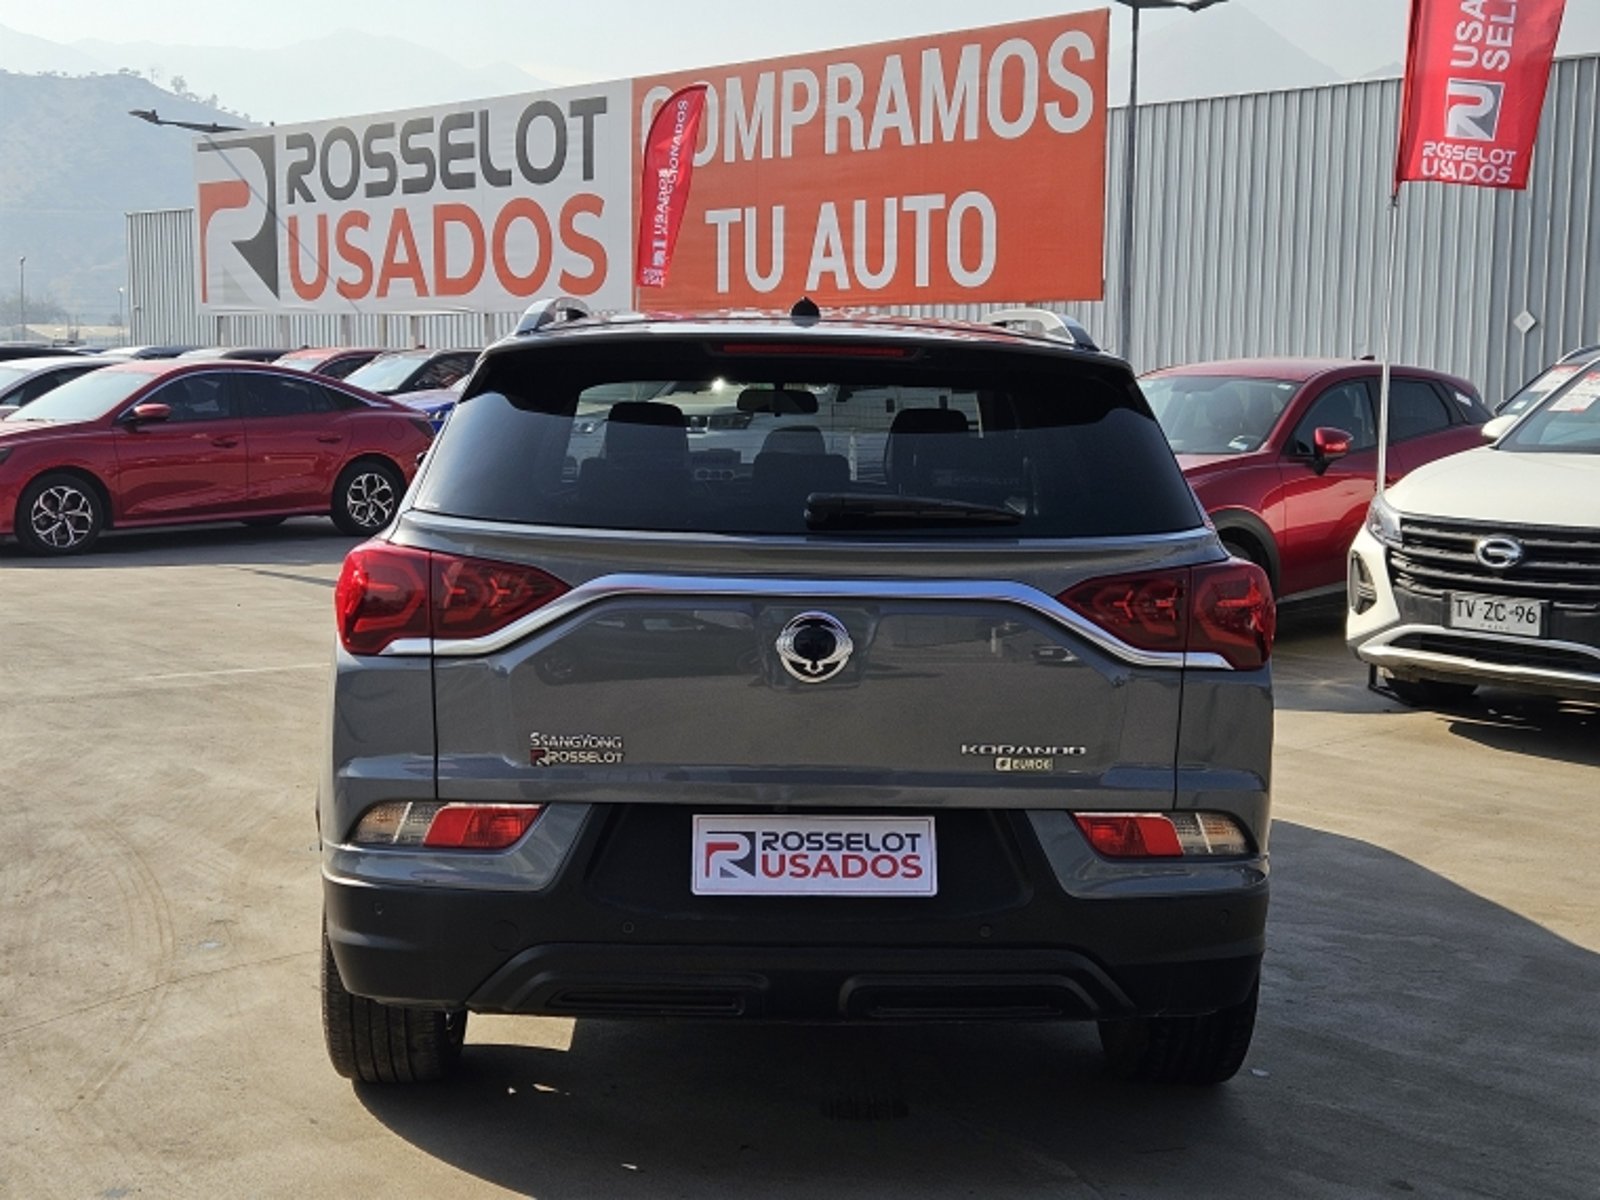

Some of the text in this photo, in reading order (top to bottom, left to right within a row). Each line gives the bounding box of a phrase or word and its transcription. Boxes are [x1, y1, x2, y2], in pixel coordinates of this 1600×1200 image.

[1481, 0, 1517, 72] SEL
[286, 96, 607, 204] ROSSELOT
[1422, 141, 1516, 164] ROSSELOT
[1421, 158, 1512, 184] USADOS
[287, 193, 608, 300] USADOS
[705, 191, 997, 293] TU AUTO
[549, 751, 624, 763] ROSSELOT
[961, 744, 1087, 754] KORANDO
[762, 831, 921, 852] ROSSELOT
[761, 854, 923, 878] USADOS
